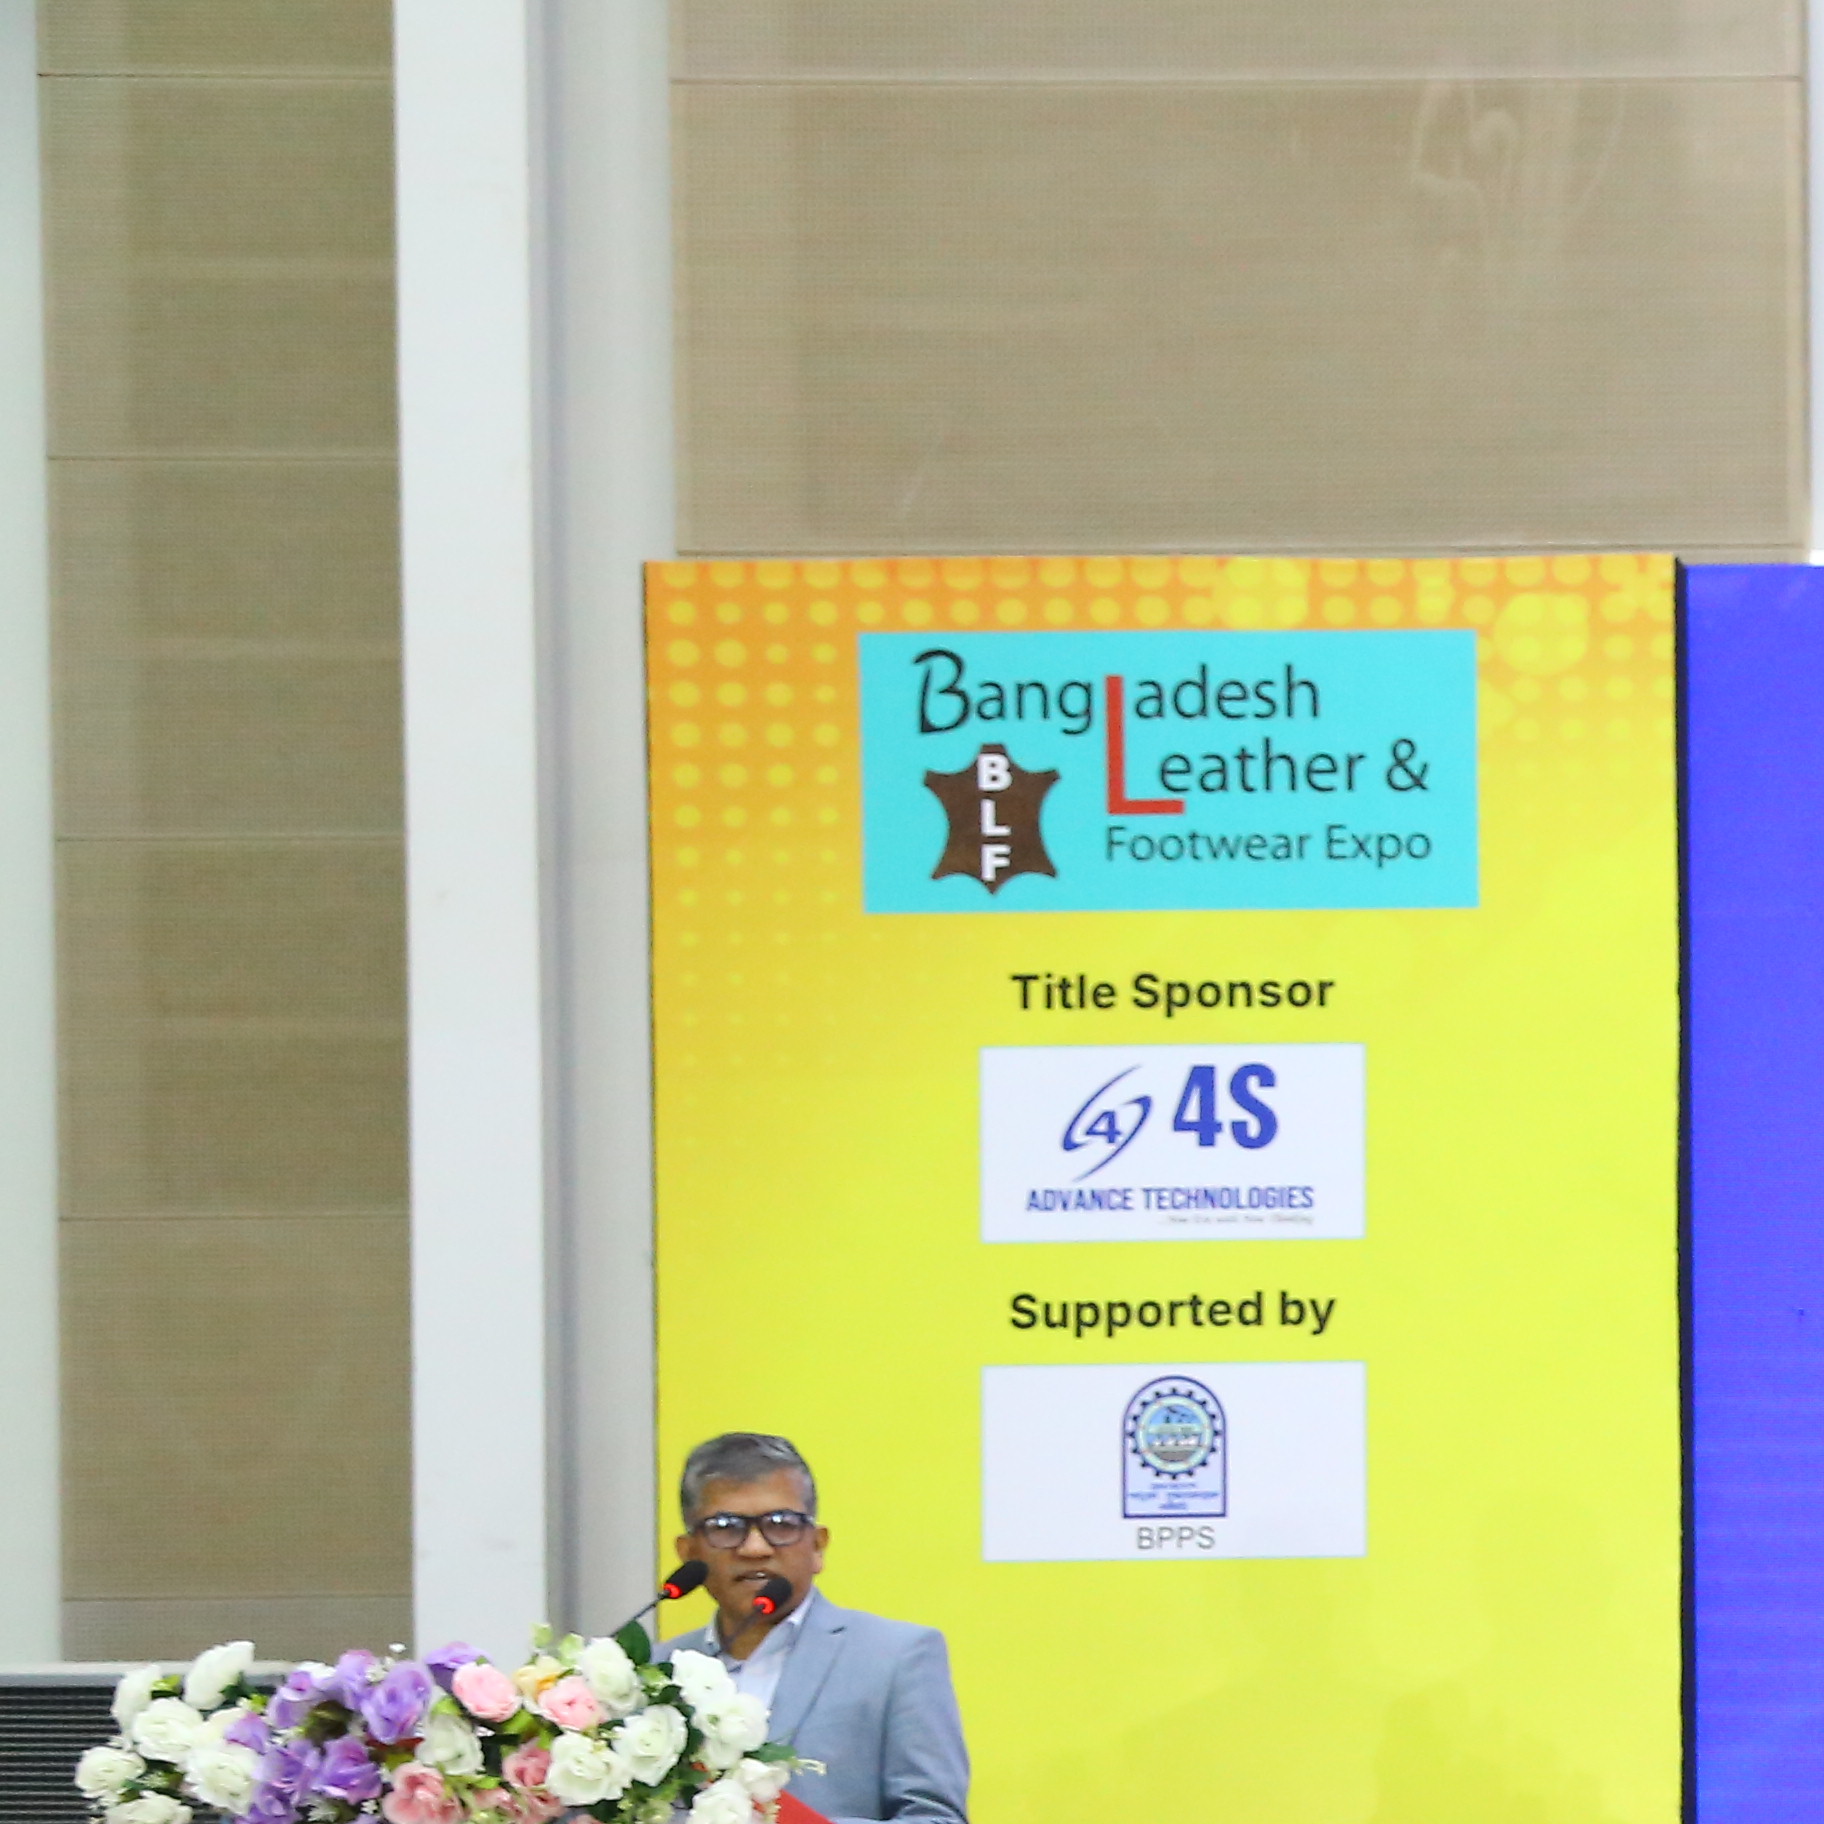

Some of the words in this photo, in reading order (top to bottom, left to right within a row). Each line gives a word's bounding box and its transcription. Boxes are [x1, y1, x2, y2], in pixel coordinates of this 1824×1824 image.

[1386, 738, 1428, 792] &
[1107, 826, 1310, 862] Footwear
[1326, 824, 1432, 868] Expo
[1011, 973, 1117, 1010] Title
[1132, 973, 1335, 1019] Sponsor
[1173, 1063, 1278, 1150] 4S
[1026, 1188, 1135, 1212] ADVANCE
[1142, 1186, 1315, 1210] TECHNOLOGIES
[1010, 1291, 1264, 1339] Supported
[1279, 1290, 1336, 1336] by
[1135, 1525, 1216, 1550] BPPS
